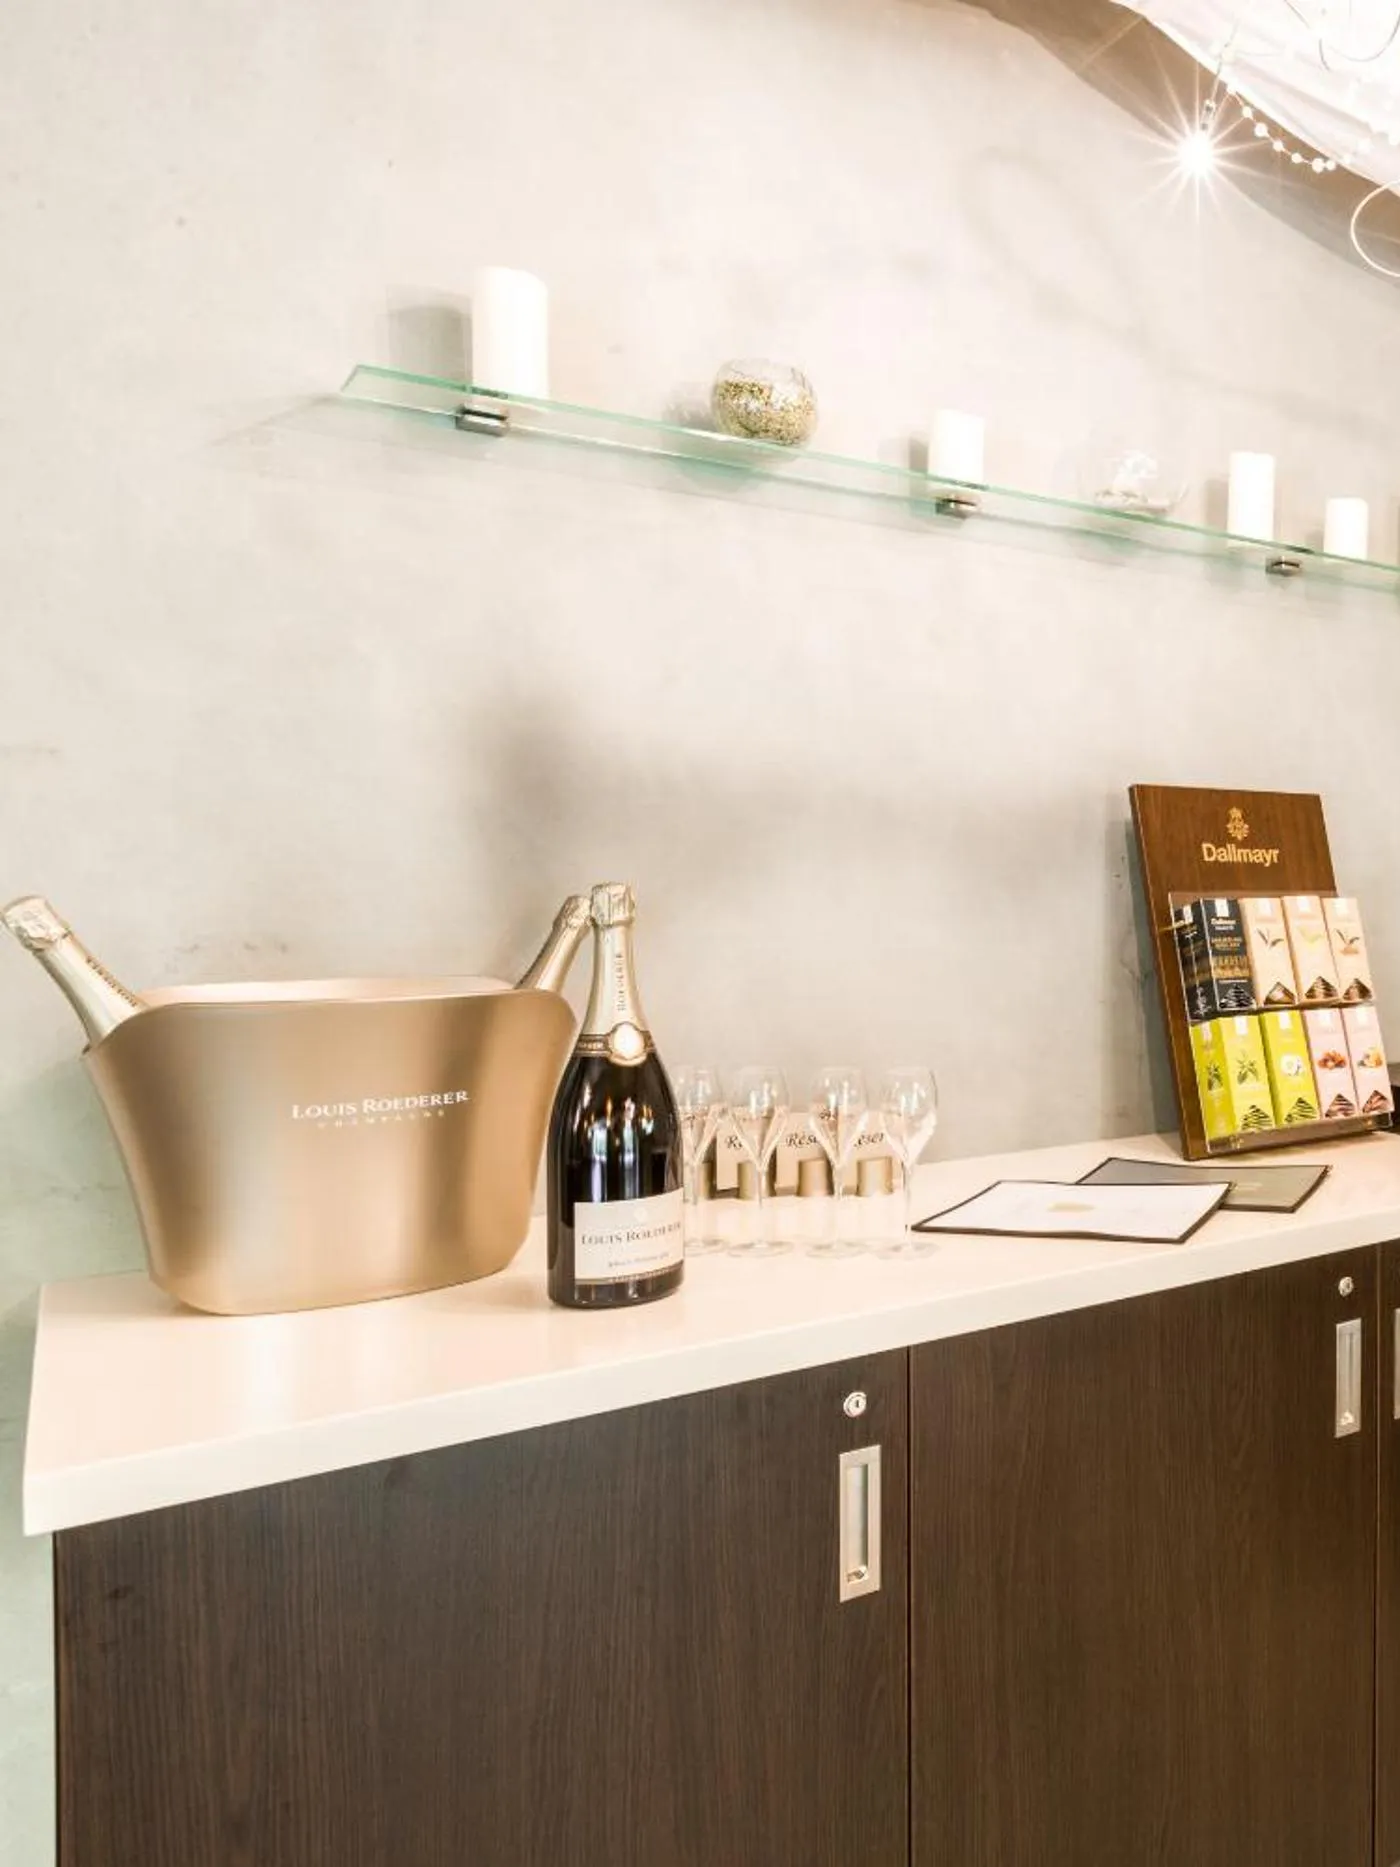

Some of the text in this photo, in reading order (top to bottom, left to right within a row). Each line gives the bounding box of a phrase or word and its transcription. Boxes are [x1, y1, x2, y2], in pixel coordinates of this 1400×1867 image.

[1201, 843, 1279, 867] Dallmayr
[292, 1090, 469, 1120] LOUIS ROEDERER
[581, 1231, 624, 1245] LOUIS
